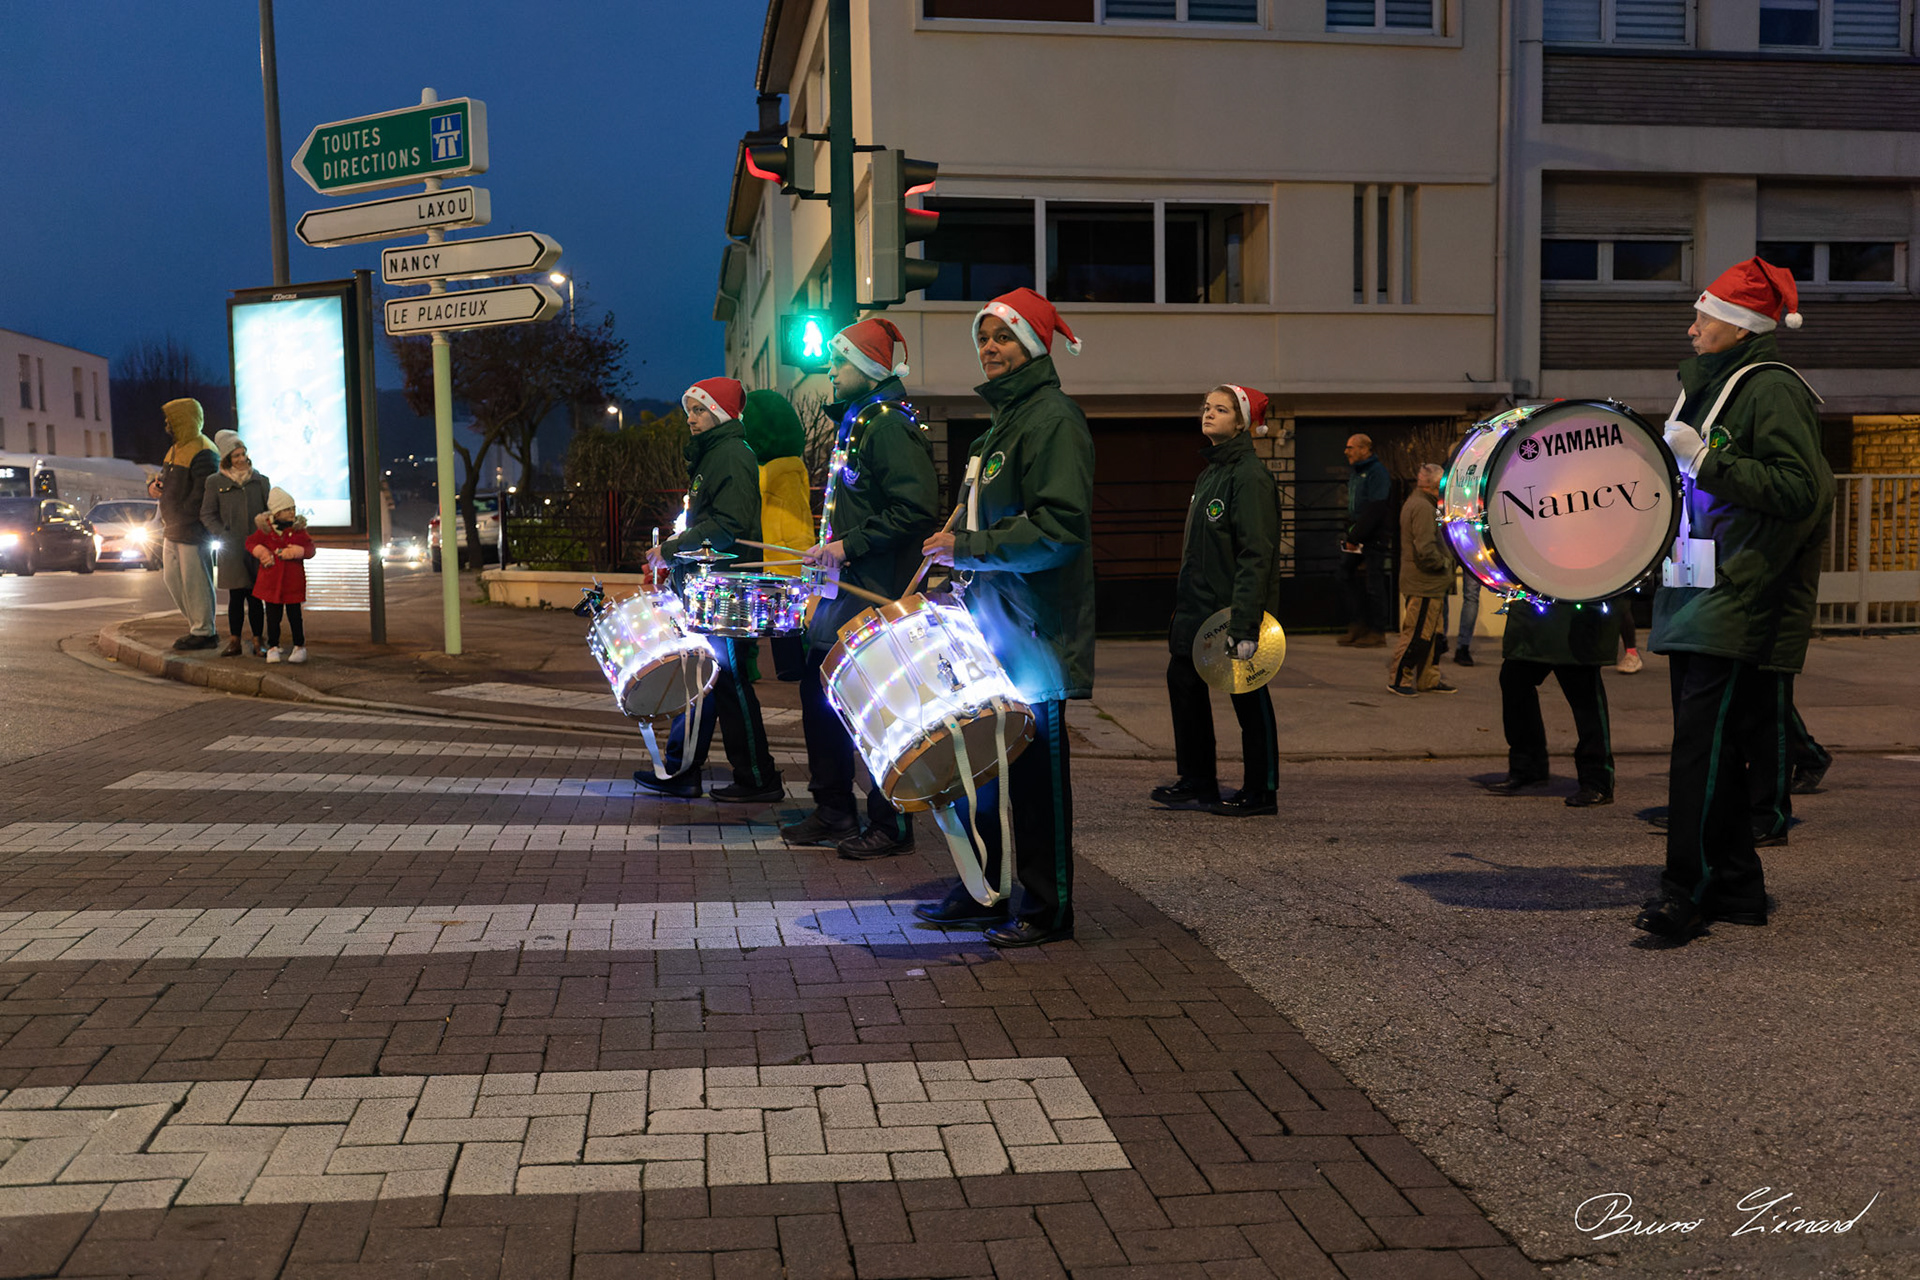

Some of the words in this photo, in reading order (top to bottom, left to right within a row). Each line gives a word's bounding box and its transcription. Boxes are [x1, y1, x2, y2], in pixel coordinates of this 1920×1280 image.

[322, 127, 381, 154] TOUTES
[323, 147, 421, 181] DIRECTIONS
[418, 197, 468, 220] LAXOU
[389, 253, 441, 274] NANCY
[393, 308, 408, 325] LE
[418, 299, 489, 322] PLACIEUX
[1541, 423, 1624, 457] YAMAHA
[1497, 480, 1661, 526] Nancy
